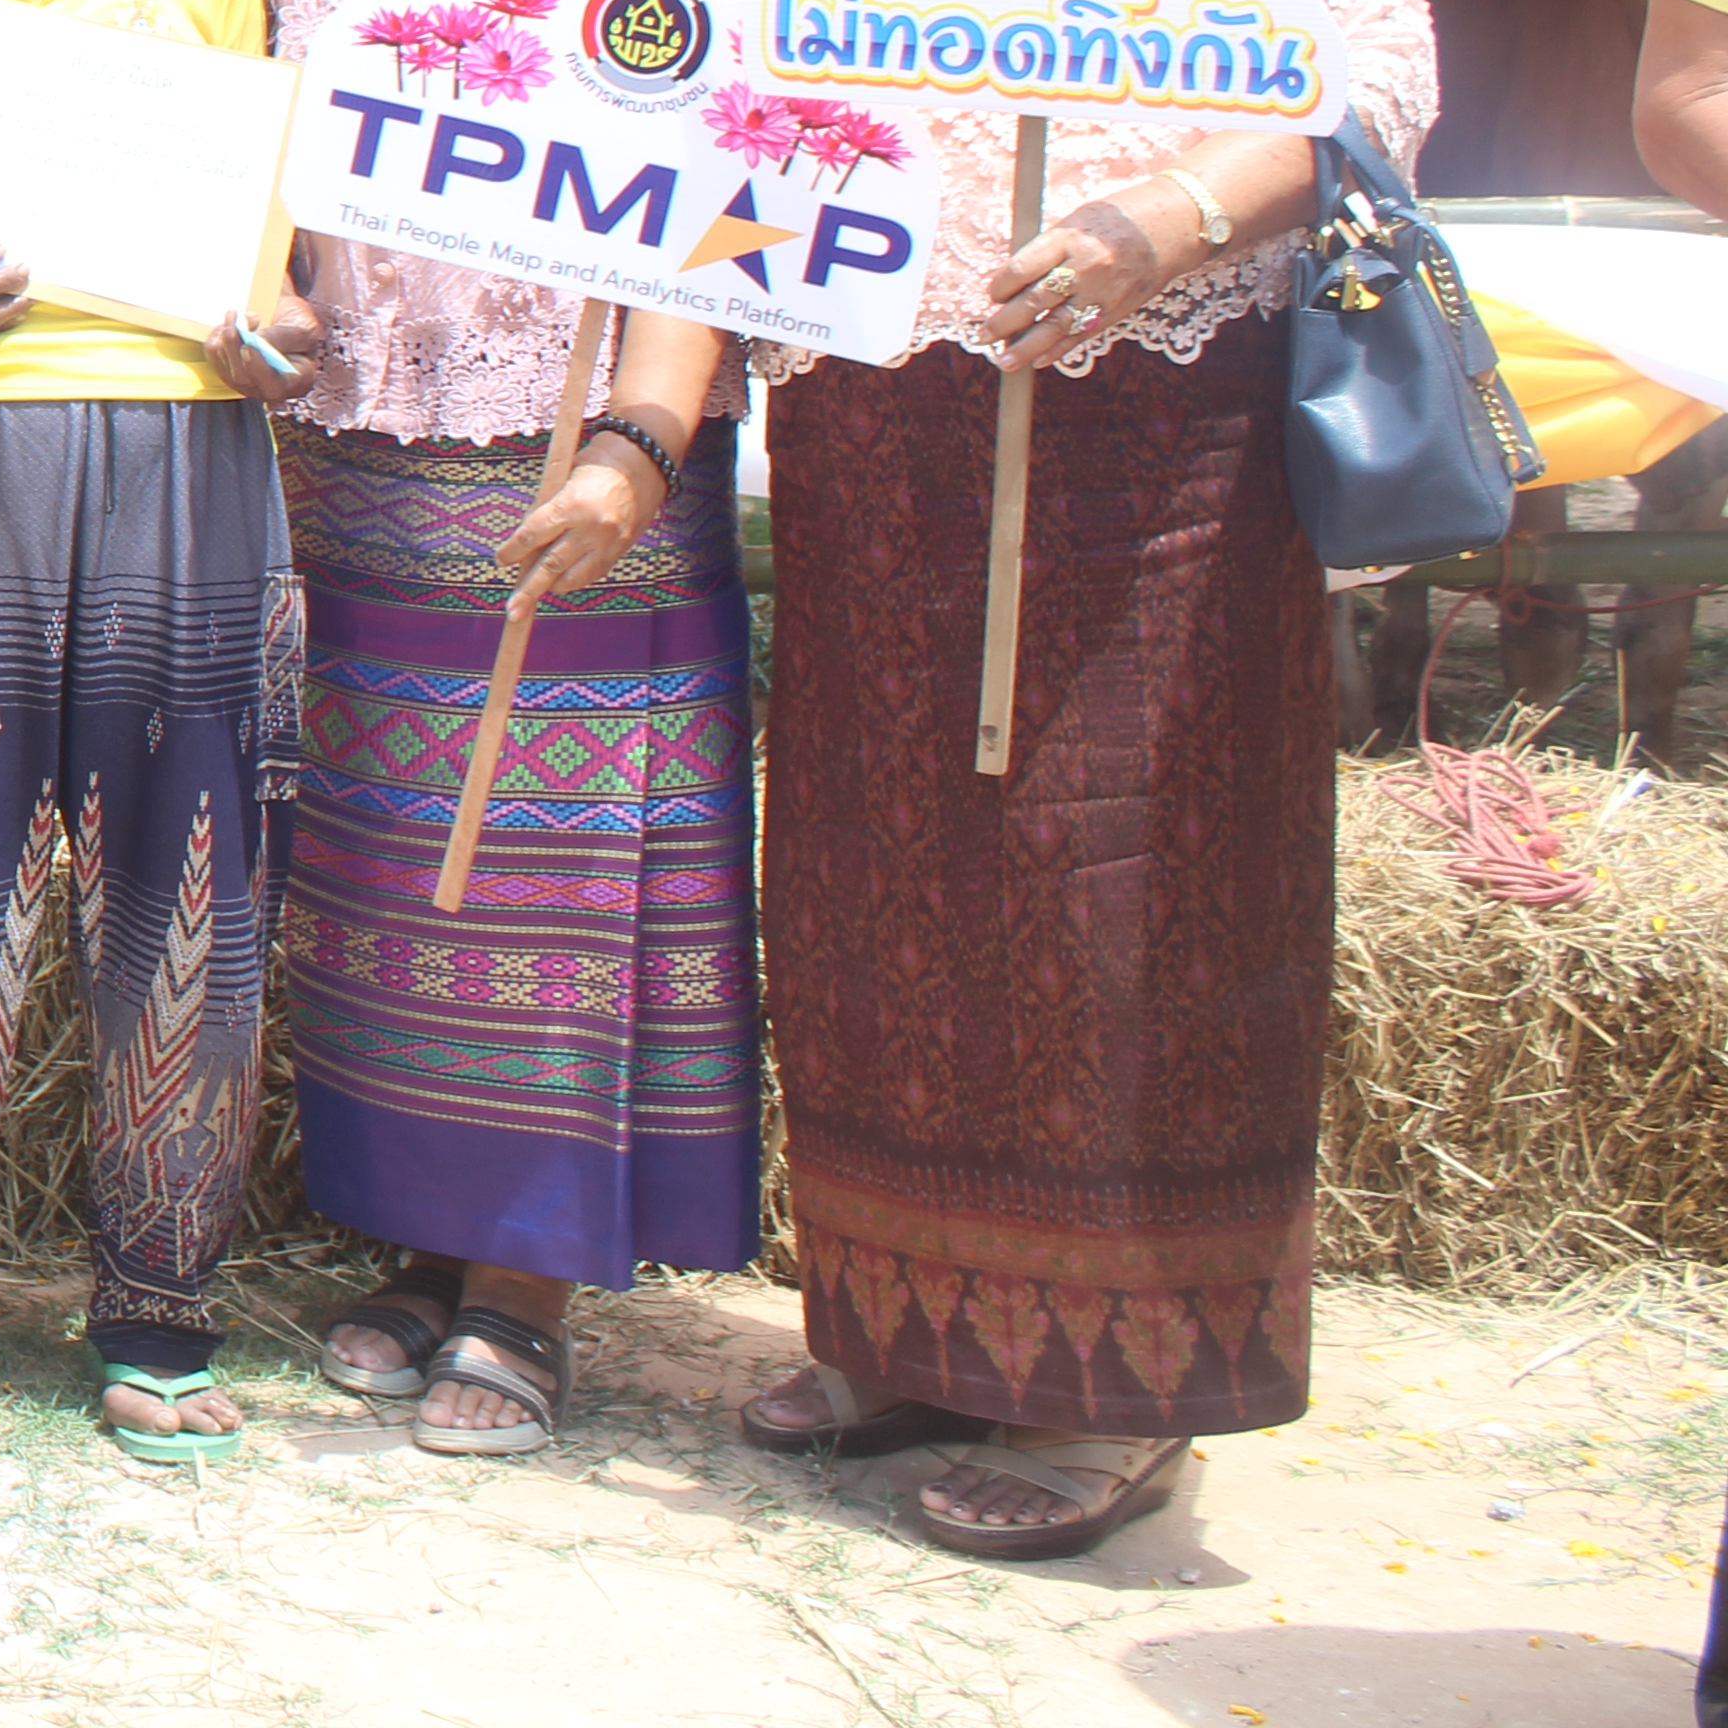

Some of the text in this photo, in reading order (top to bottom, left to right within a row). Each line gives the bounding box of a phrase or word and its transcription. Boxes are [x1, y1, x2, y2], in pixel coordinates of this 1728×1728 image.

[329, 88, 914, 294] TPMAP
[338, 203, 832, 340] Thai People Map and Analytics Platform
